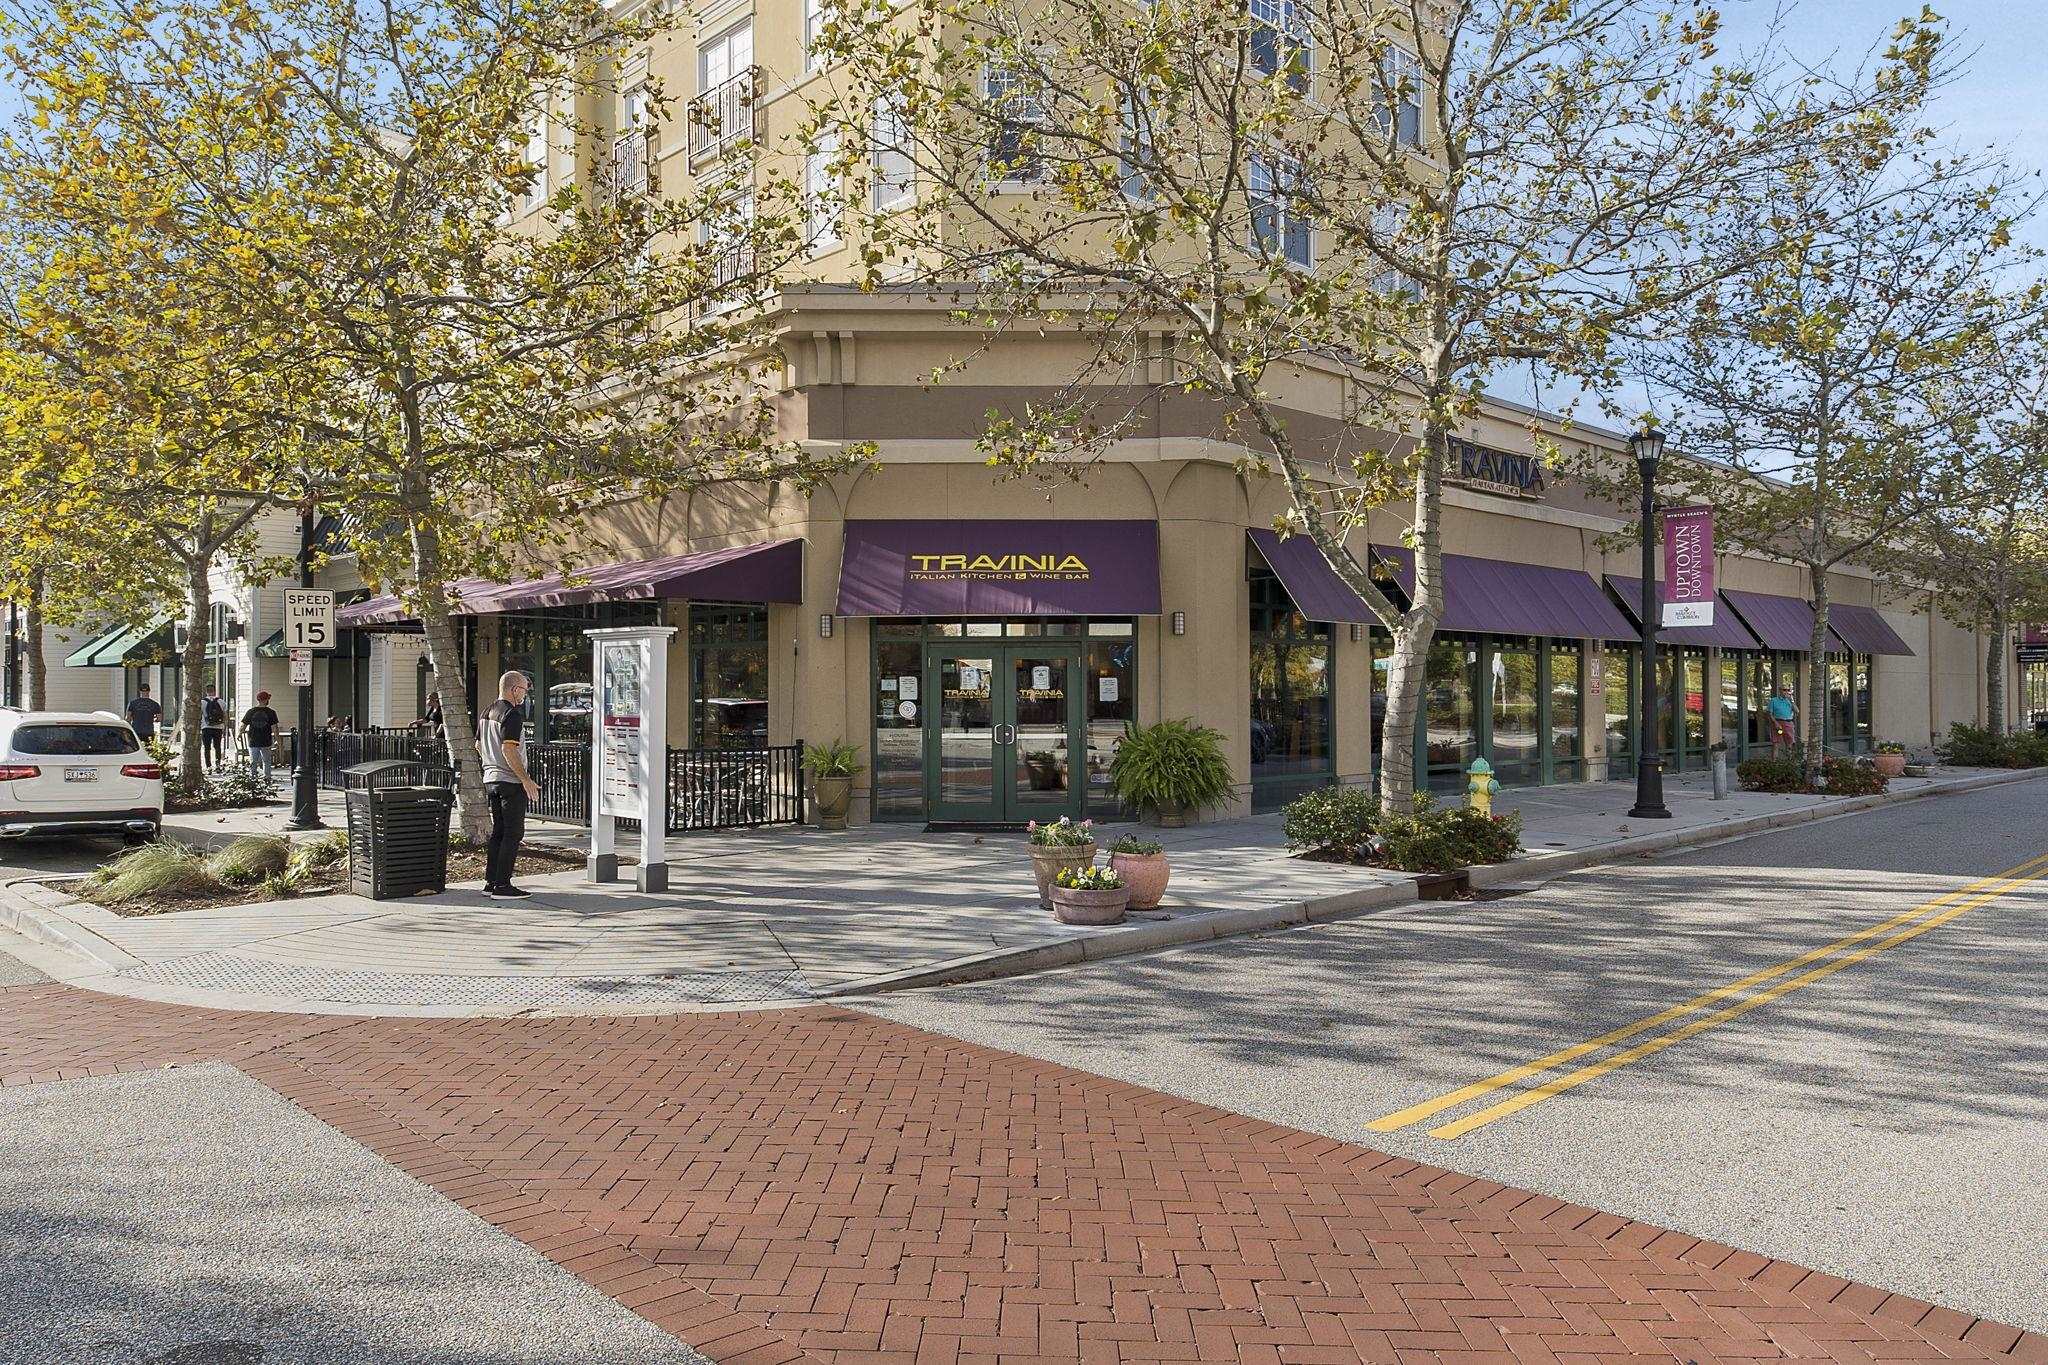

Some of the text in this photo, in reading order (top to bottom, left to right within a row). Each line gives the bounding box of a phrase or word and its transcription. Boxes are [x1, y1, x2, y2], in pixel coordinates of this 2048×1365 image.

[911, 554, 1088, 571] TRAVINIA
[1676, 526, 1691, 599] UPTOWN
[1691, 525, 1702, 596] DOWNTOWN
[960, 572, 1012, 580] KITCHEN
[1030, 572, 1061, 580] WINE
[288, 594, 331, 605] SPEED
[293, 607, 326, 617] LIMIT
[295, 622, 326, 644] 15
